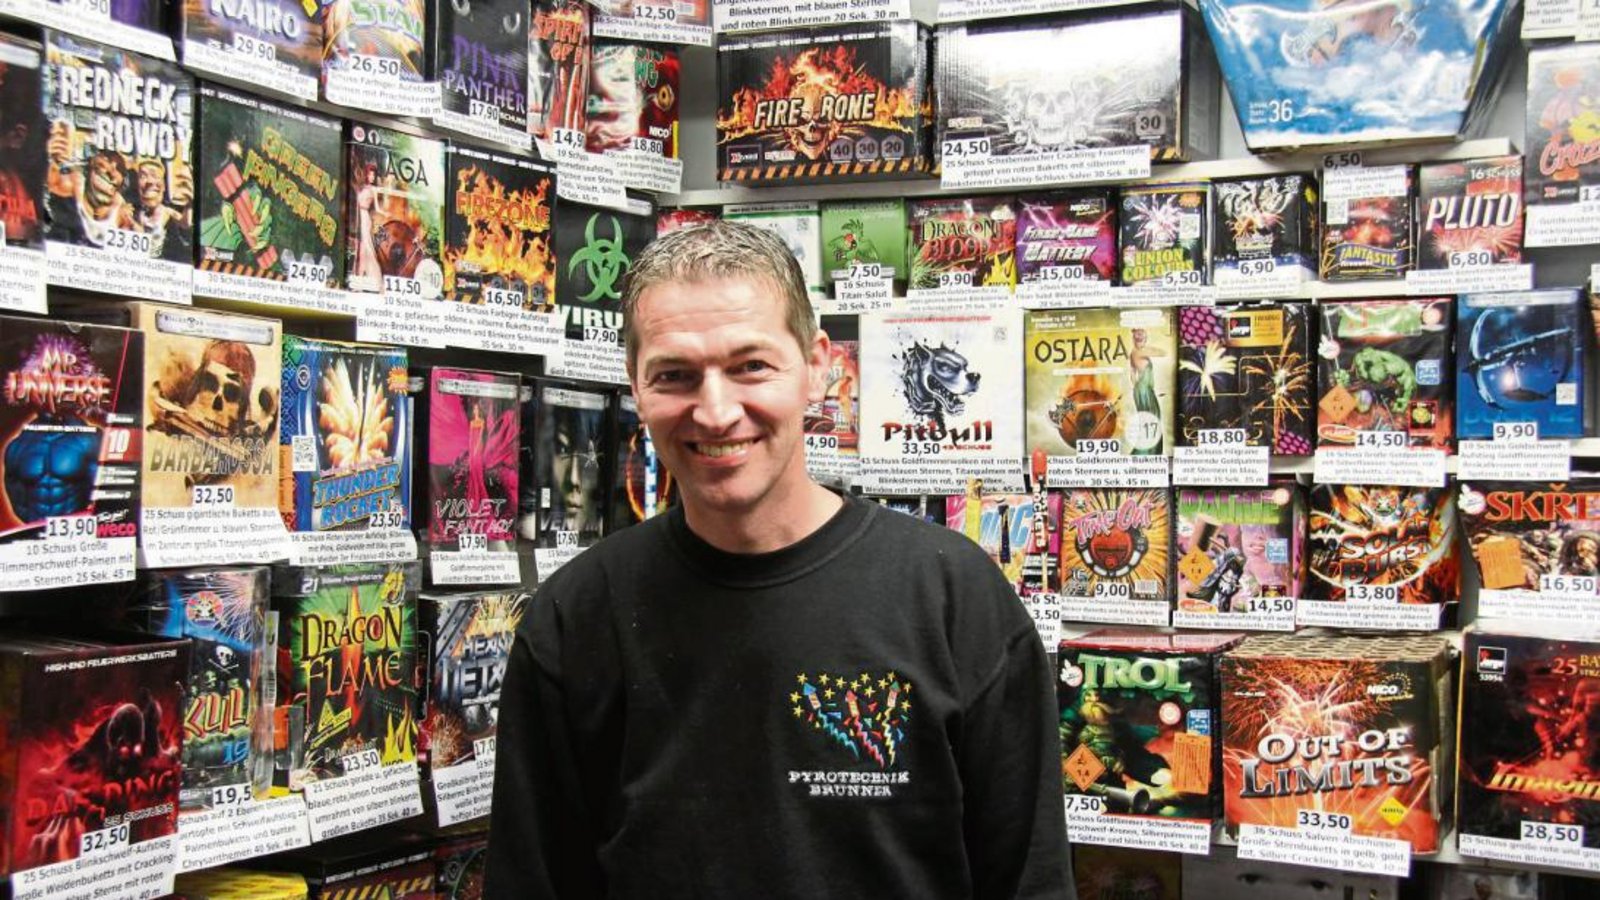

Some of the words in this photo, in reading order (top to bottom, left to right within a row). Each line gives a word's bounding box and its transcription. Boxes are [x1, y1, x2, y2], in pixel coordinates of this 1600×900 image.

[635, 6, 676, 21] 12,50
[729, 5, 792, 17] Blinksternen,
[795, 4, 812, 12] mit
[814, 0, 848, 11] blauen
[721, 20, 738, 30] und
[740, 19, 767, 29] roten
[769, 14, 831, 27] Blinksternen
[834, 14, 847, 22] 20
[874, 10, 886, 19] 30
[236, 36, 275, 61] 29,90
[351, 56, 400, 77] 26,50
[60, 65, 177, 122] REDNECK
[444, 68, 525, 115] PANTHER
[471, 103, 499, 120] 17,90
[754, 98, 803, 129] FIRE
[1268, 99, 1293, 123] 36
[1139, 115, 1162, 130] 30
[649, 126, 669, 138] NICO
[633, 139, 663, 154] 18,80
[834, 143, 850, 156] 40
[859, 140, 876, 154] 30
[884, 138, 902, 153] 20
[944, 140, 990, 157] 24,50
[261, 127, 338, 201] GREEN
[958, 158, 985, 168] Schuss
[1323, 153, 1361, 169] 6,50
[1471, 168, 1485, 180] 16
[1425, 193, 1519, 231] PLUTO
[922, 218, 1000, 242] DRAGON
[106, 230, 150, 252] 23,80
[1134, 249, 1184, 265] UNION
[1339, 247, 1398, 266] FANTASTIC
[1450, 252, 1490, 267] 6,80
[290, 264, 326, 282] 24,90
[849, 265, 880, 280] 7,50
[1040, 267, 1083, 280] 15,00
[1239, 260, 1274, 275] 6,90
[385, 276, 421, 295] 11,50
[856, 280, 886, 289] Schuss
[940, 272, 972, 286] 9,90
[486, 289, 522, 307] 16,50
[841, 291, 887, 300] Titan-Salut
[553, 303, 624, 329] VIRU
[584, 328, 617, 343] 17,90
[1034, 336, 1129, 364] OSTARA
[8, 371, 112, 406] UNIVERSE
[881, 419, 993, 447] Pitbull
[1143, 422, 1158, 440] 17
[1200, 430, 1245, 445] 18,80
[1495, 424, 1535, 439] 9,90
[107, 429, 131, 454] 10
[806, 436, 837, 450] 4,90
[902, 442, 940, 456] 33,50
[1077, 440, 1120, 454] 19,90
[1357, 433, 1404, 448] 14,50
[150, 435, 274, 475] BARBAROSSA
[1075, 467, 1111, 475] Sternen
[313, 464, 399, 506] THUNDER
[194, 487, 234, 506] 32,50
[320, 488, 396, 528] ROCKET
[435, 498, 508, 519] VIOLET
[49, 517, 95, 539] 13,90
[370, 512, 402, 529] 23,50
[96, 522, 137, 537] weco
[557, 531, 579, 545] 17,90
[42, 543, 78, 554] Schuss
[460, 535, 487, 549] 17,90
[301, 577, 319, 593] 21
[1096, 583, 1128, 596] 9,00
[1347, 585, 1396, 599] 13,80
[1542, 577, 1594, 592] 16,50
[1043, 594, 1061, 605] St.
[1249, 599, 1294, 614] 14,50
[1034, 609, 1060, 621] 3,50
[300, 605, 404, 662] DRAGON
[45, 660, 87, 673] HIGH-END
[87, 649, 178, 669] FEUERWERKSBATTERIE
[1552, 657, 1579, 675] 25
[300, 651, 403, 712] FLAME
[1077, 653, 1192, 693] TROL
[1367, 685, 1399, 696] NICO
[1258, 732, 1345, 763] OUT
[1357, 725, 1413, 753] OF
[344, 751, 379, 773] 23,50
[788, 770, 910, 784] PYROTECHNIK
[1239, 755, 1414, 799] LIMITS
[809, 784, 892, 797] BRUNNER
[1065, 796, 1100, 812] 7,50
[1299, 812, 1350, 830] 33,50
[84, 825, 129, 852] 32,50
[1523, 824, 1580, 842] 28,50
[23, 872, 38, 884] 25
[39, 863, 74, 882] Schuss
[117, 863, 133, 875] mit
[93, 881, 124, 898] Sterne
[124, 879, 140, 889] mit
[140, 871, 165, 886] roten
